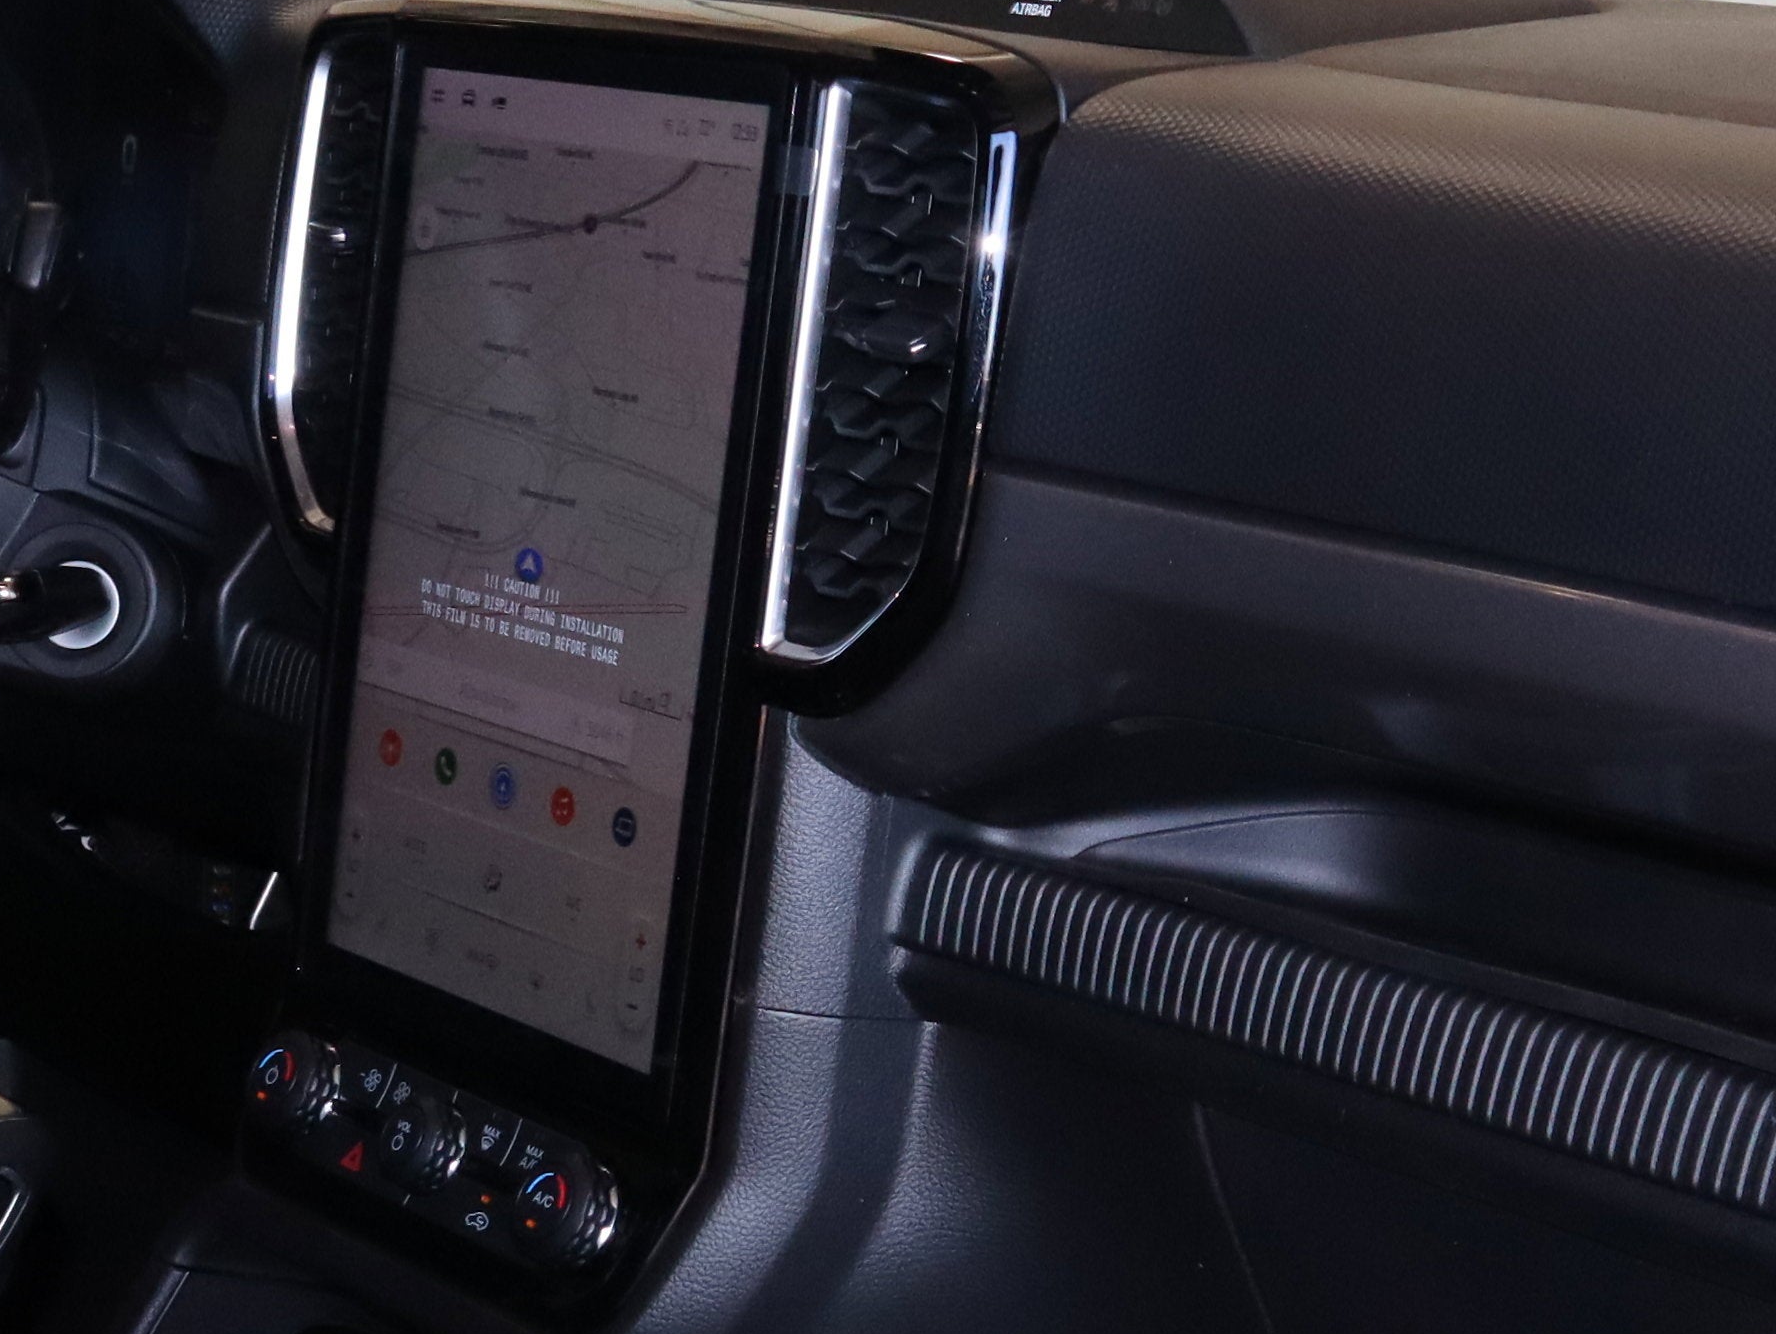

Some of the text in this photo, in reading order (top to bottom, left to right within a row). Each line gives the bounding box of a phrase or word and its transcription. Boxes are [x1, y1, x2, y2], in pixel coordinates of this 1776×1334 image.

[1010, 2, 1053, 17] AIRBAG
[504, 578, 541, 600] CAUTION
[421, 579, 624, 644] DO NOT TOUCH DISPLAY DURING INSTALLATION
[422, 600, 619, 666] THIS FILM IS TO BE REMOVED BEFORE USAGE
[397, 1119, 412, 1134] VOL
[483, 1124, 502, 1140] MAX
[525, 1144, 545, 1160] MAX
[532, 1190, 555, 1209] A/C
